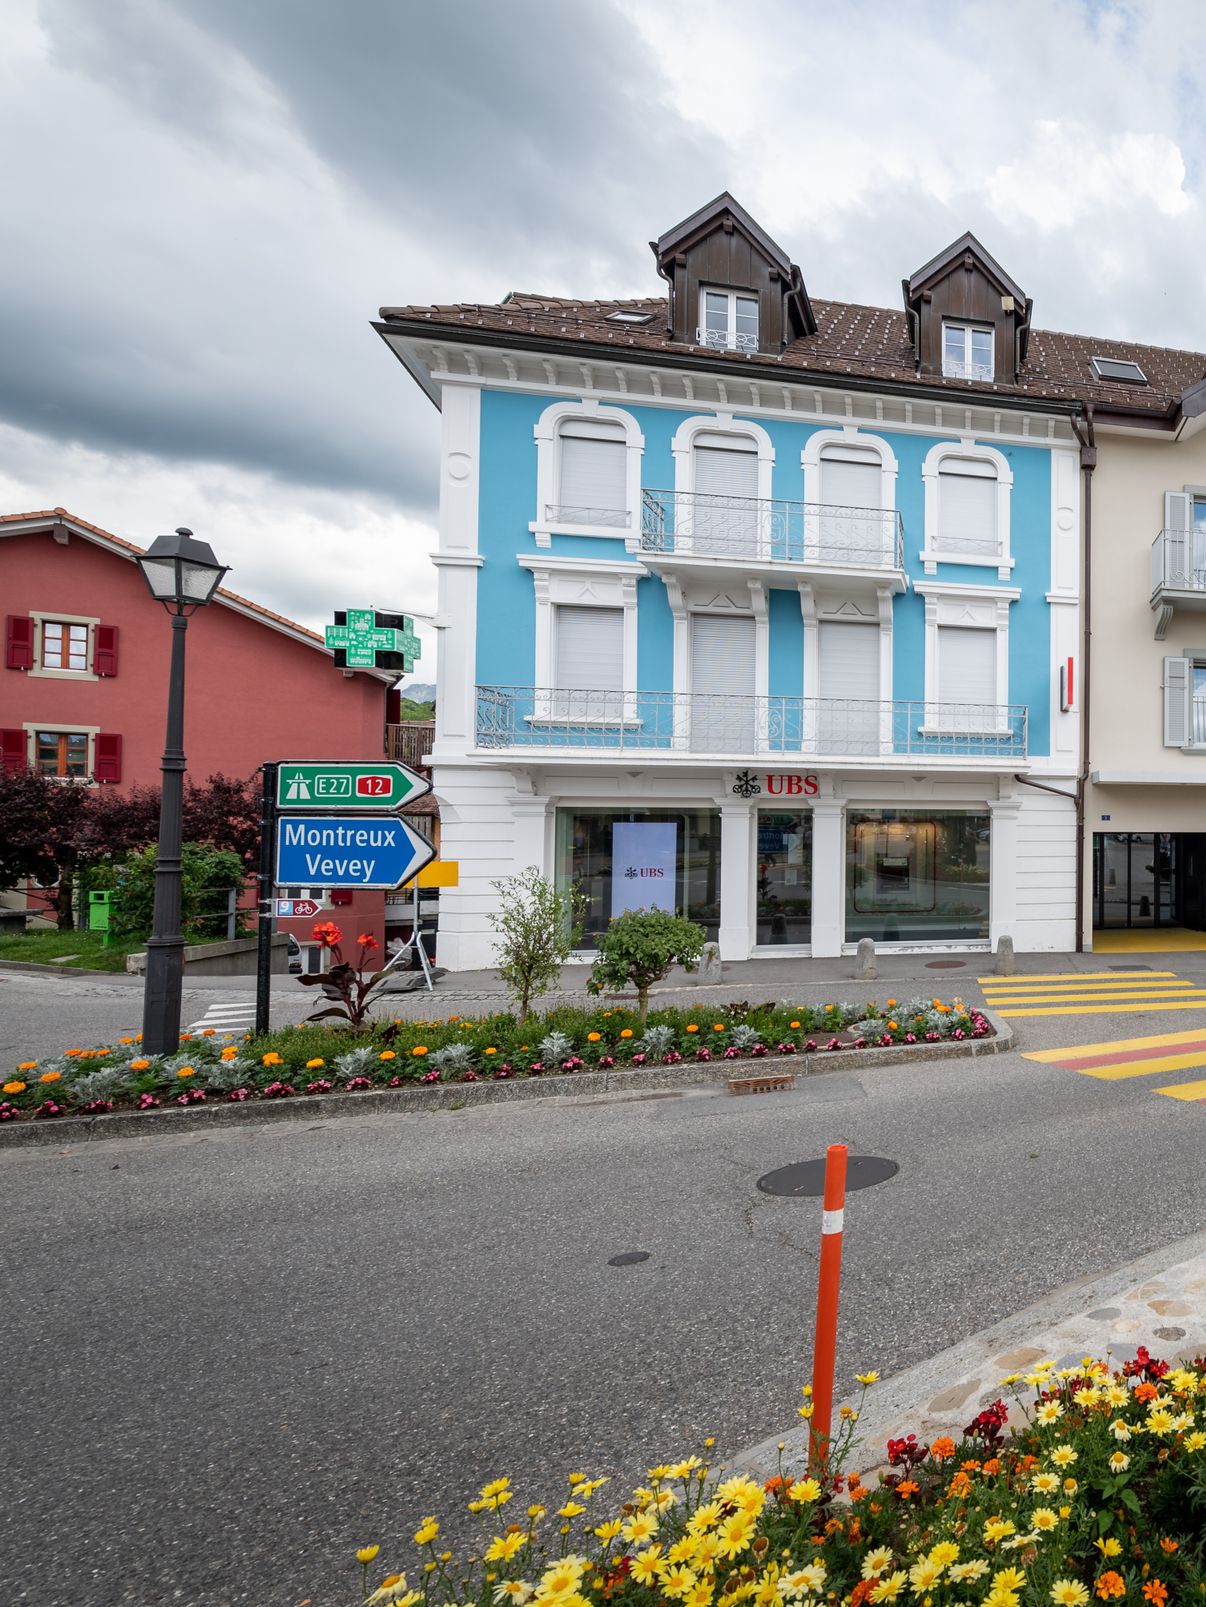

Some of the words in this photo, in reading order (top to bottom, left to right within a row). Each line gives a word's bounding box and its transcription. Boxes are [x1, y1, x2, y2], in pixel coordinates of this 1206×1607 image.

[366, 779, 383, 793] 12
[766, 774, 818, 795] UBS
[285, 824, 396, 847] Montreux
[305, 854, 375, 882] Vevey
[640, 867, 664, 879] UBS
[280, 901, 289, 912] 9
